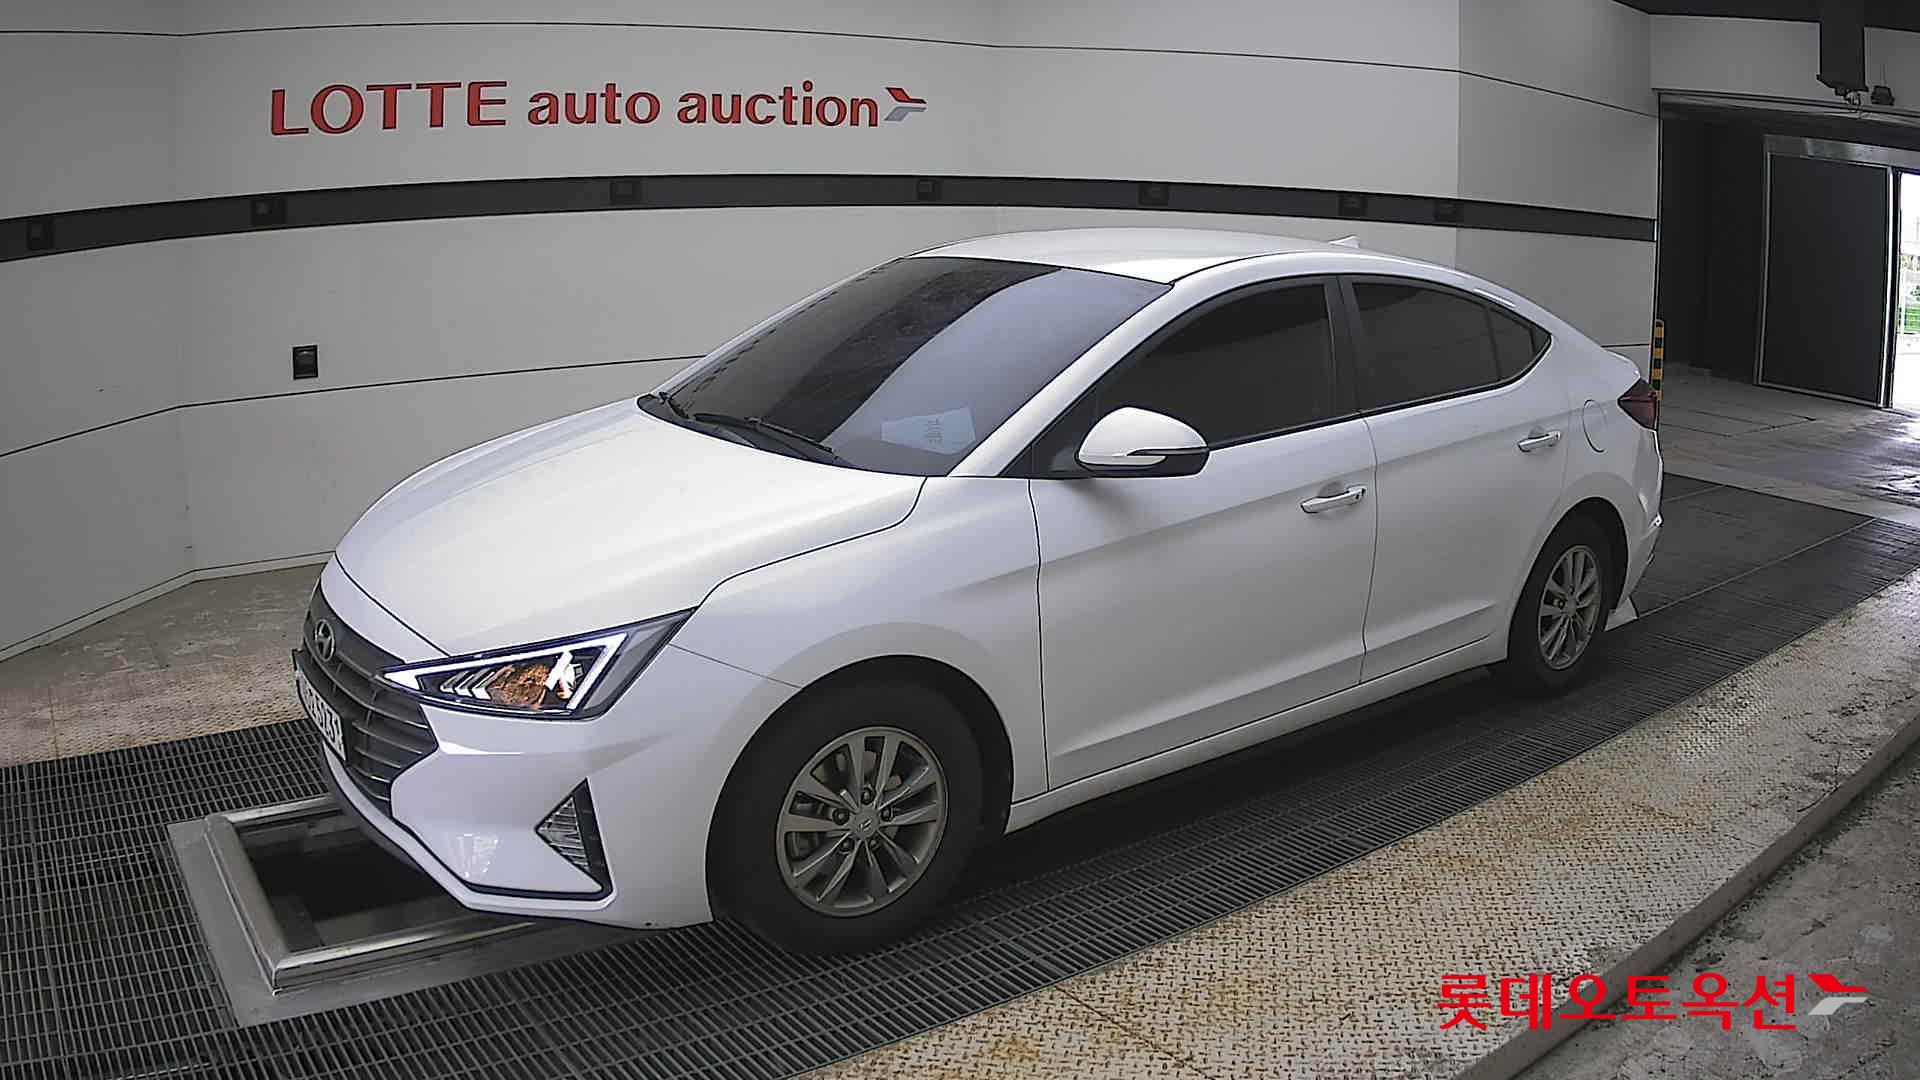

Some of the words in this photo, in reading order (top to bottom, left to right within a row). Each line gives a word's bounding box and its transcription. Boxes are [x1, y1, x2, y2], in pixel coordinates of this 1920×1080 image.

[271, 80, 508, 136] LOTTE
[526, 82, 661, 126] auto
[677, 80, 880, 128] auction
